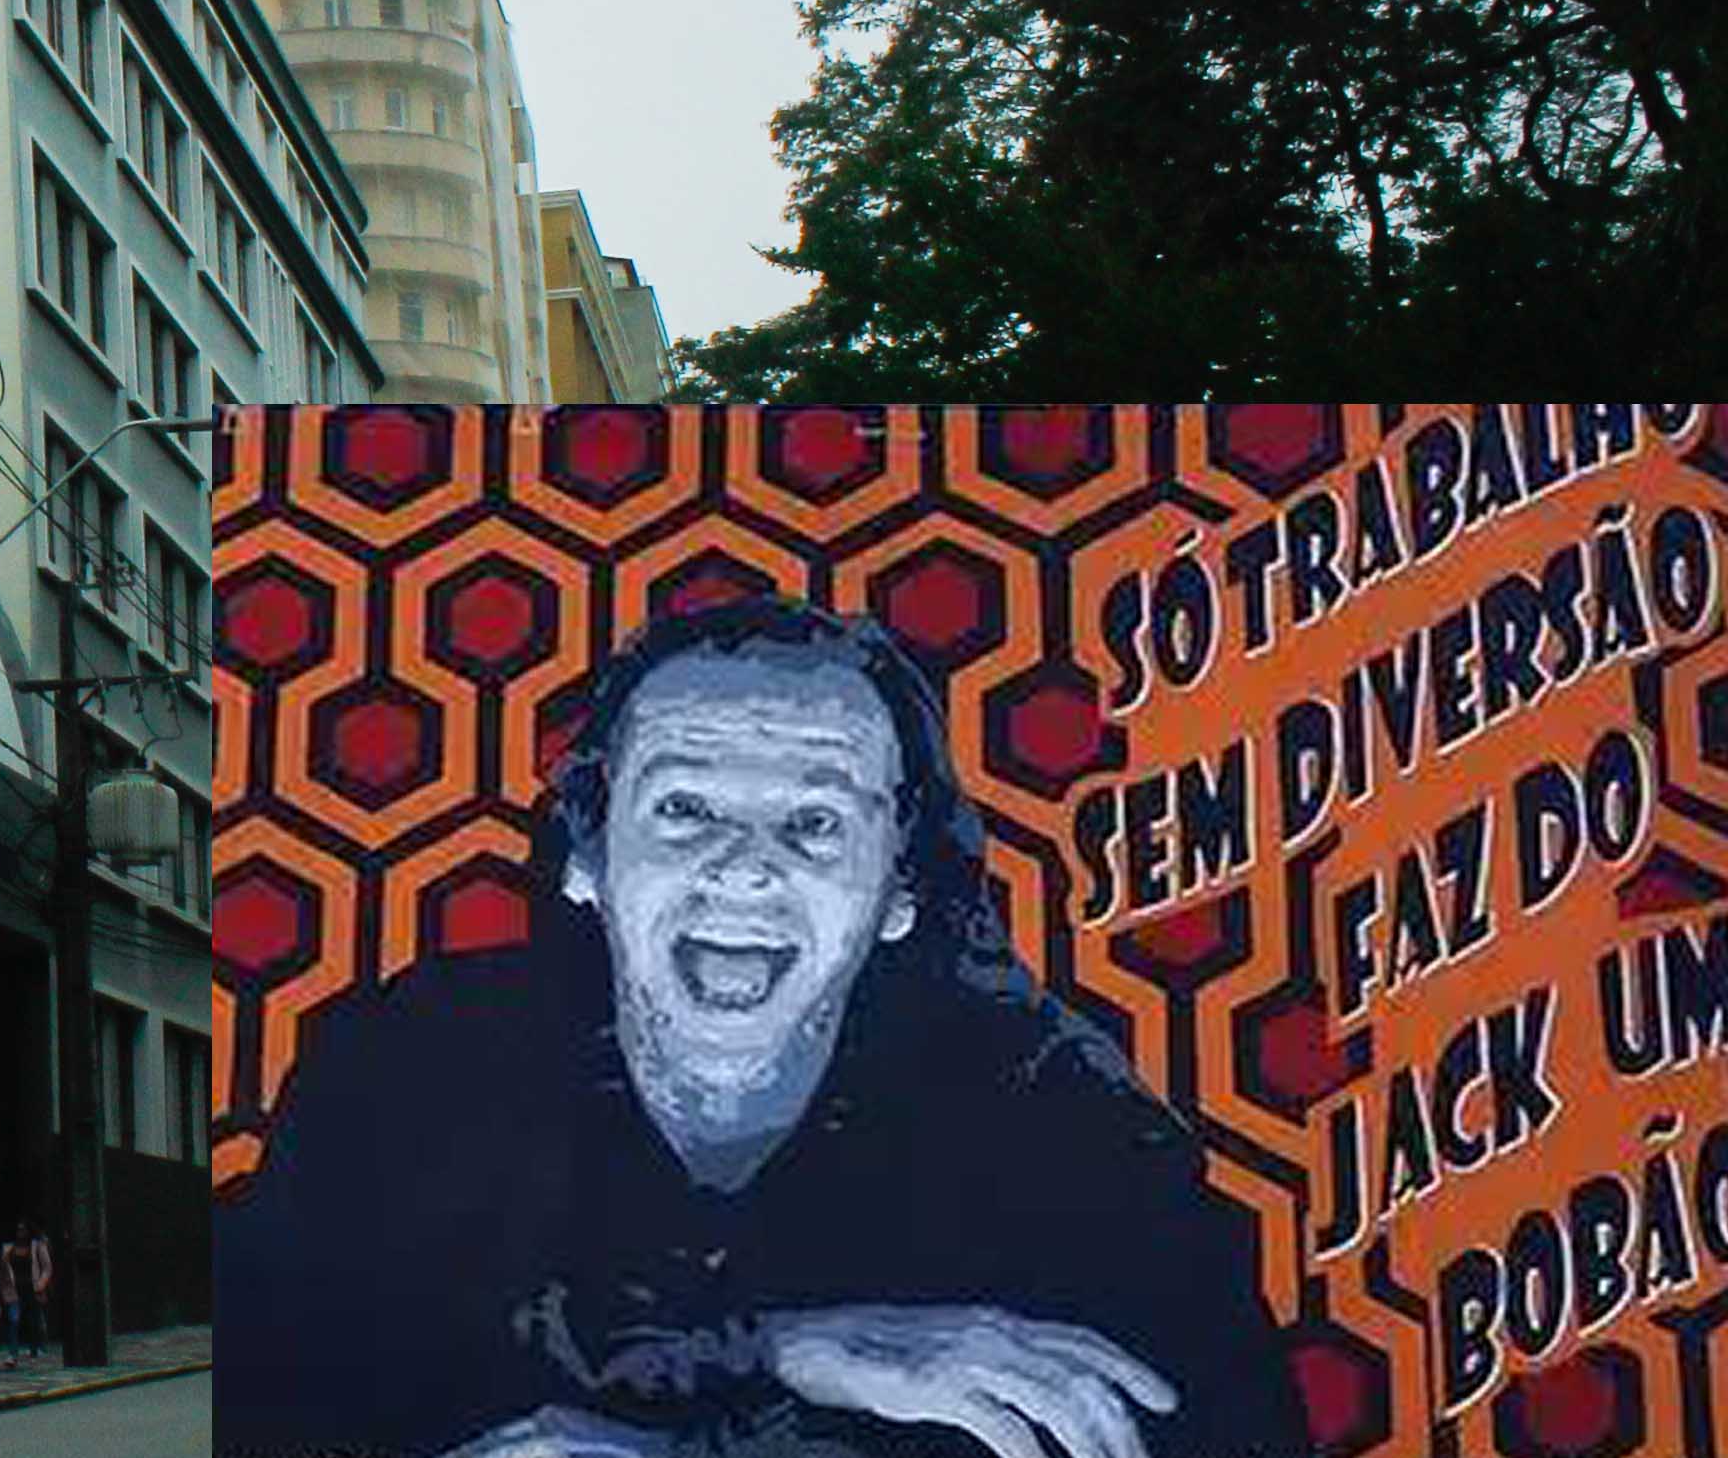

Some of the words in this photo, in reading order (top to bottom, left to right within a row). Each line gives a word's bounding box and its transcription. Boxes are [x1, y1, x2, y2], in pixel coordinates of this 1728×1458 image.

[1073, 735, 1257, 930] SEM
[1276, 501, 1722, 849] DIVERSÃO
[1100, 527, 1221, 719] SÓ
[1226, 404, 1701, 659] TRABALH
[1334, 795, 1497, 1025] FAZ
[1514, 727, 1656, 917] DO
[1315, 984, 1564, 1262] JACK
[1597, 913, 1728, 1081] UM
